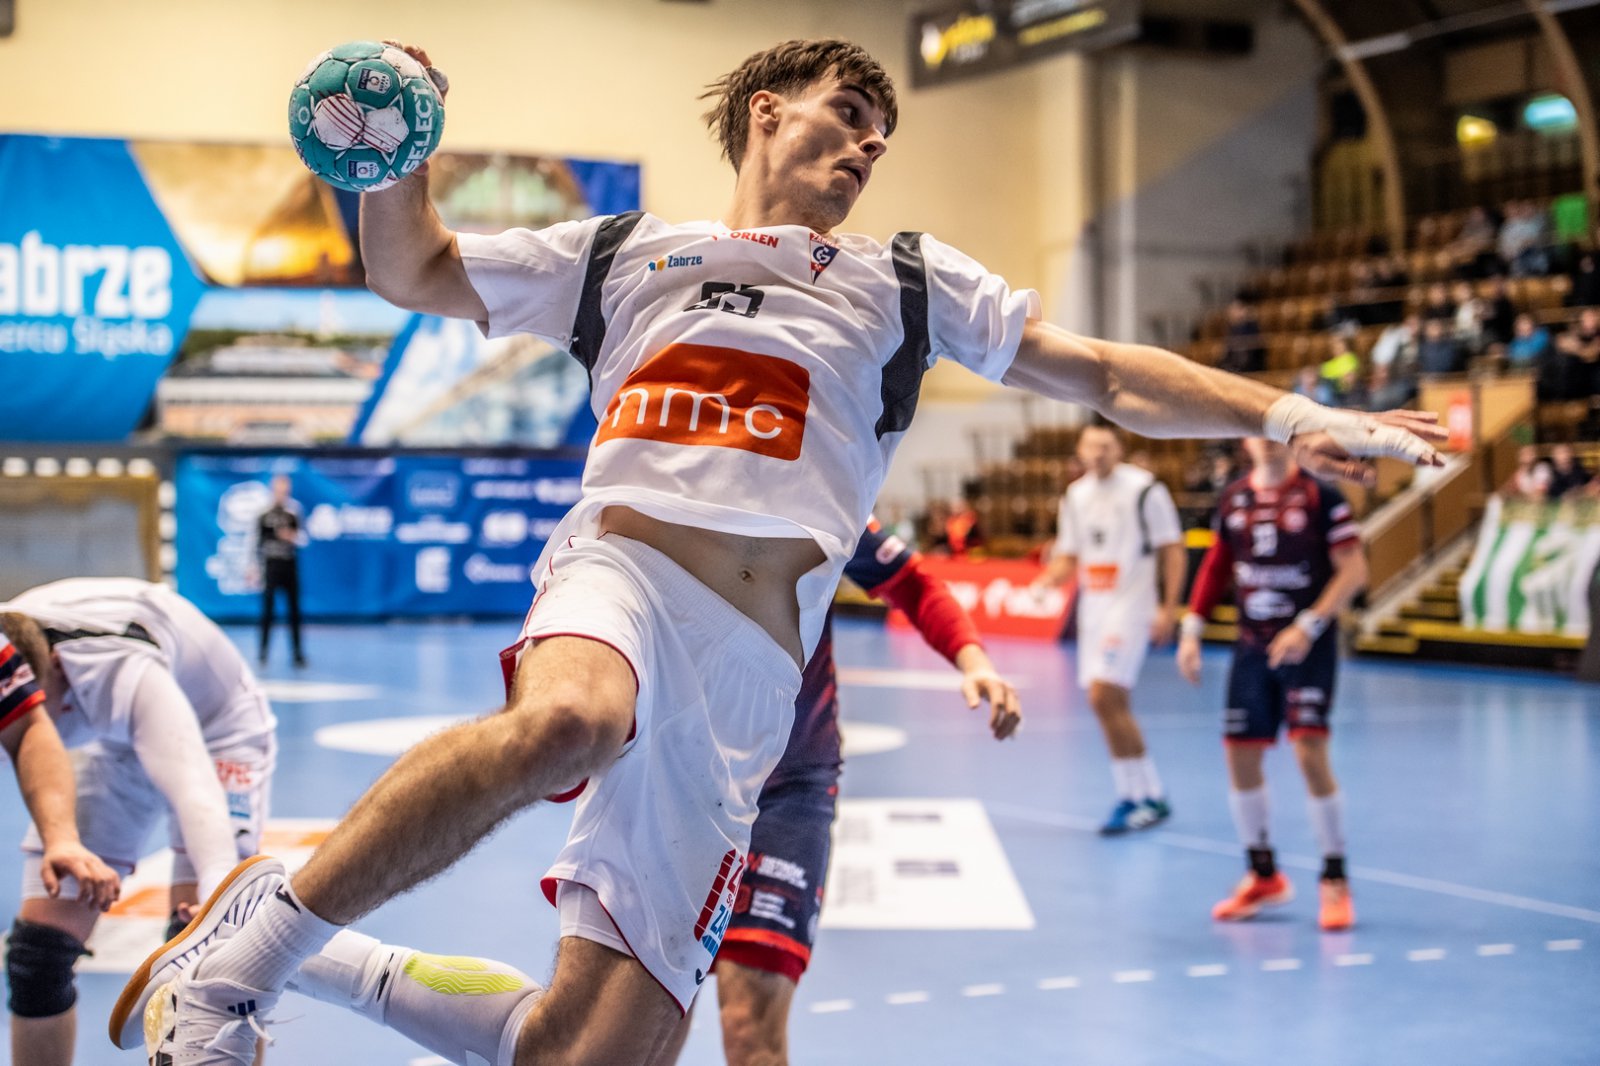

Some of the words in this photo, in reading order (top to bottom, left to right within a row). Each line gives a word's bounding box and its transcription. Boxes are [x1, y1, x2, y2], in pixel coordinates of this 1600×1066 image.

[401, 85, 433, 174] SELECT
[730, 232, 779, 248] ORLEN
[667, 255, 703, 268] Zabrze
[611, 387, 784, 439] nmc
